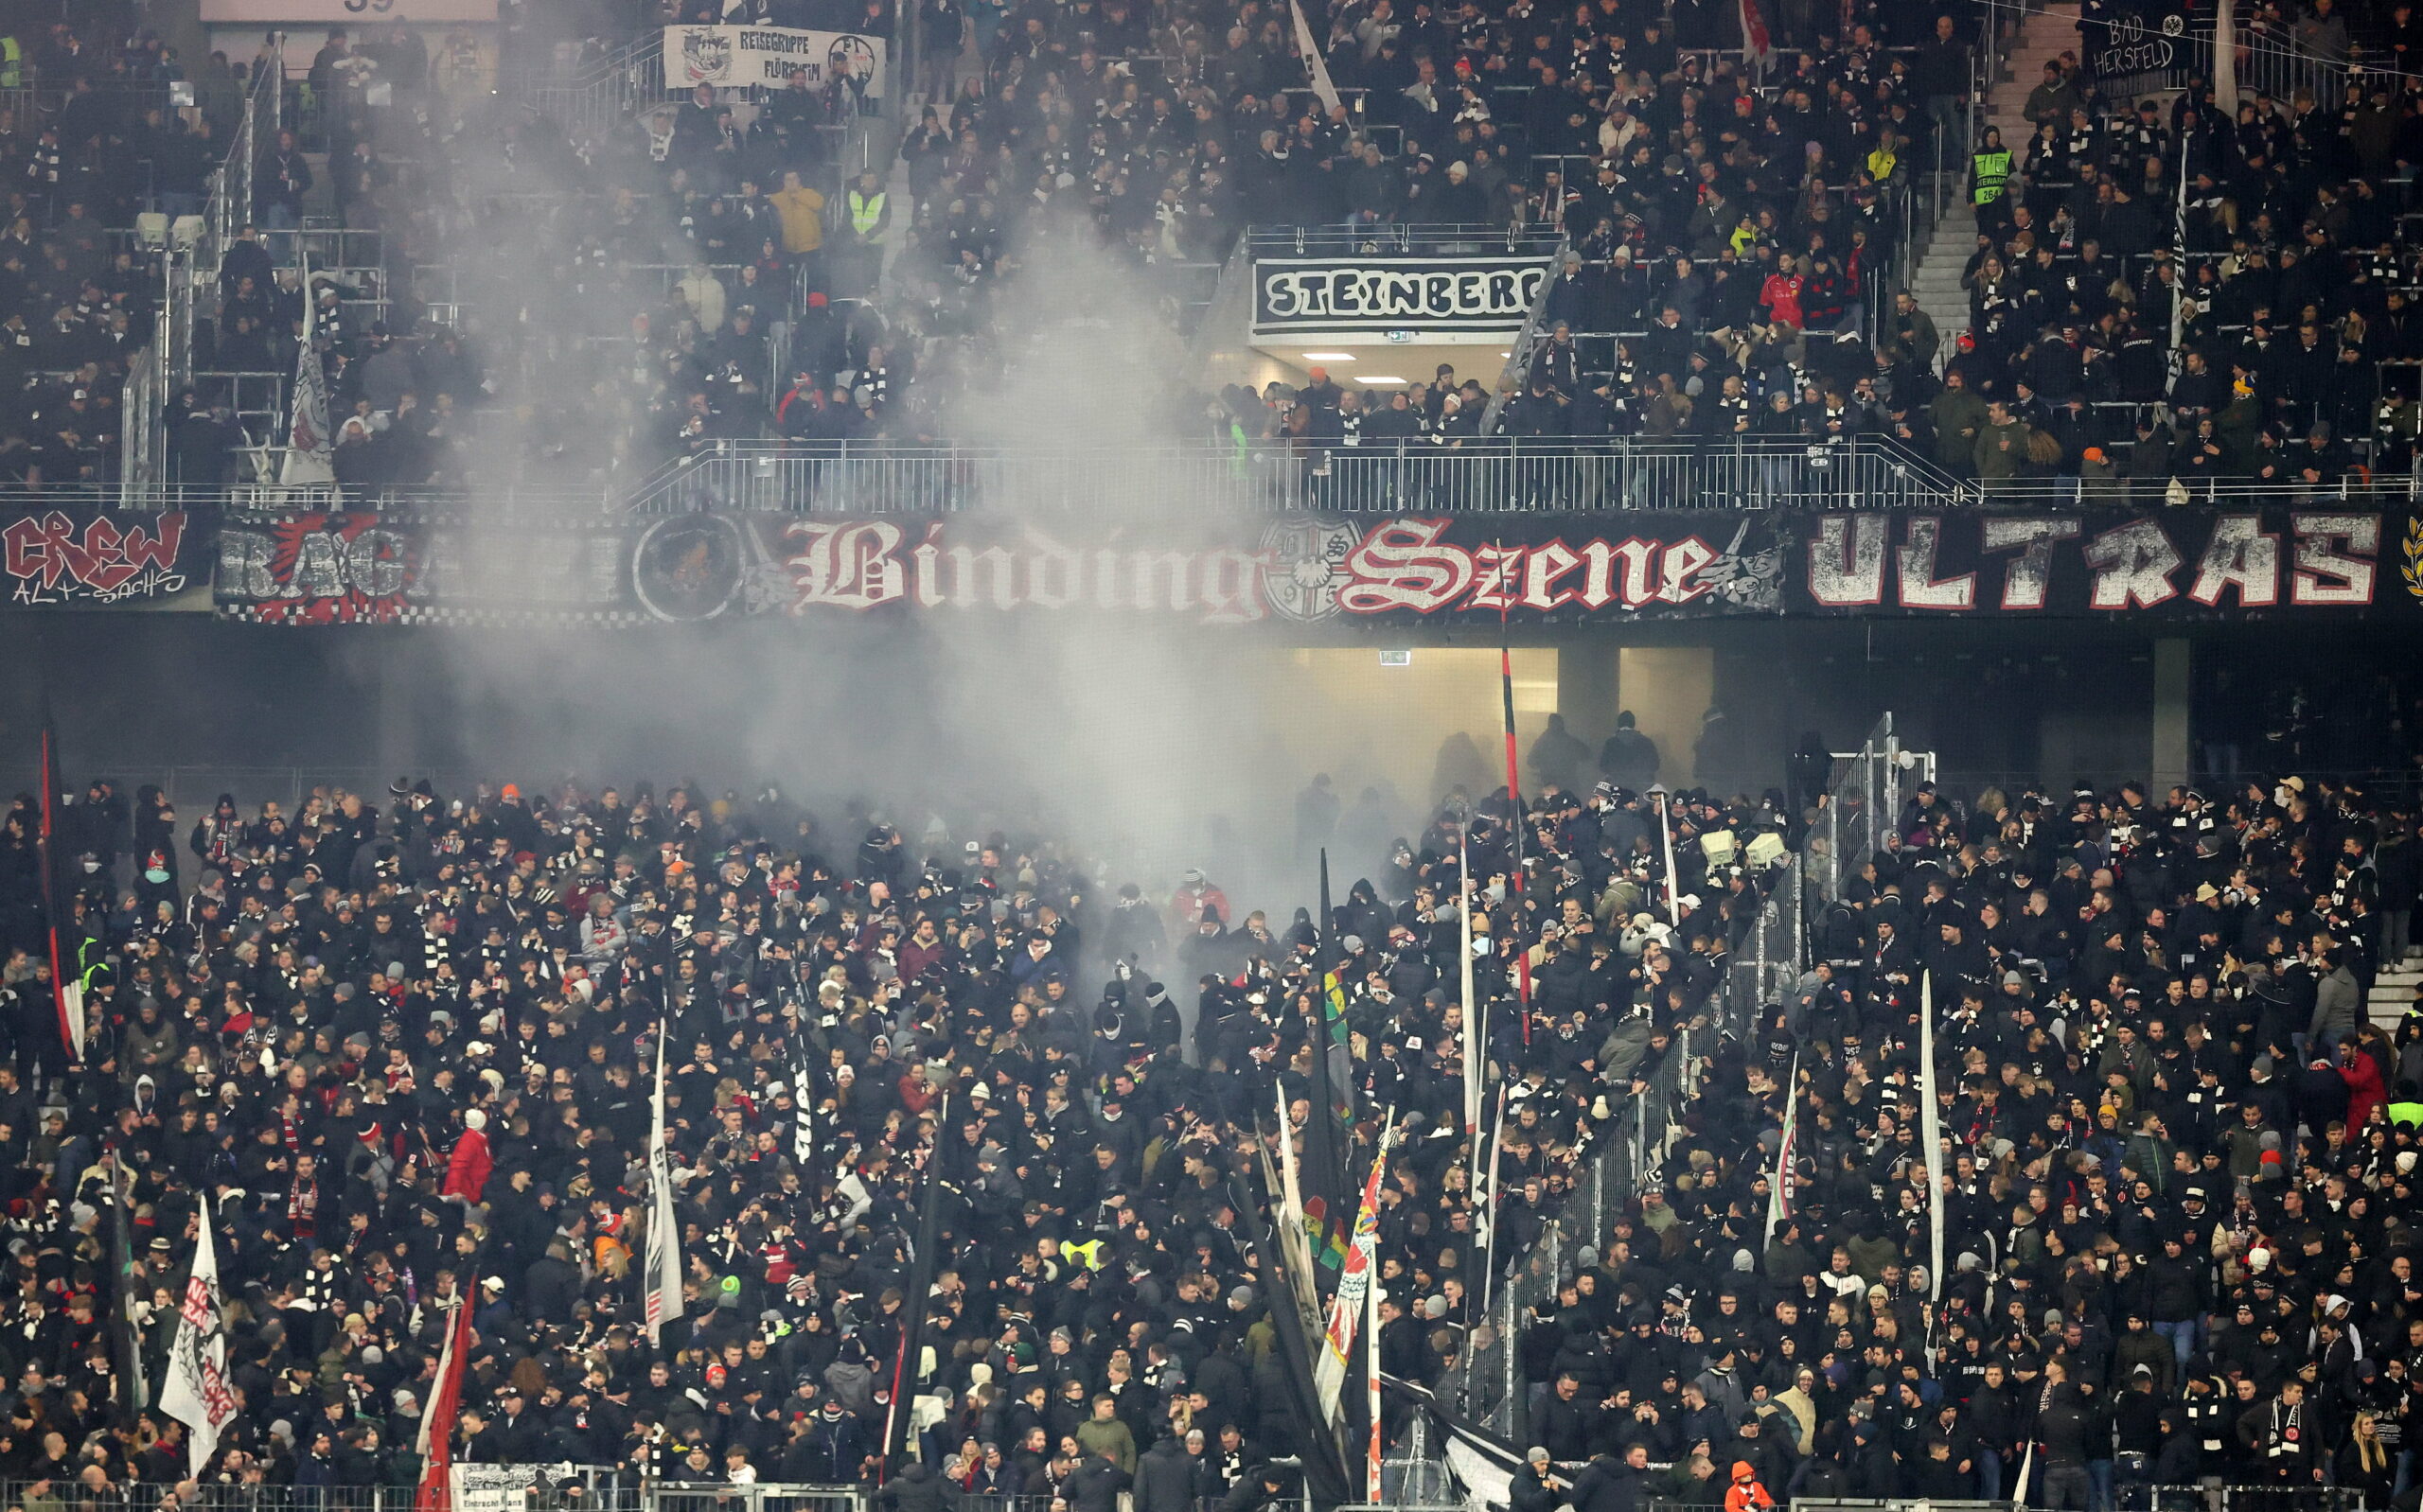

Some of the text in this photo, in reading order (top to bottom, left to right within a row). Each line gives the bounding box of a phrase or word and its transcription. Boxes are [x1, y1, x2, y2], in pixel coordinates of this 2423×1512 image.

[2094, 39, 2173, 77] HERSFELD
[2108, 15, 2144, 45] BAD
[2, 511, 187, 591] CREW
[787, 519, 1273, 624] Binding
[1340, 517, 1724, 614] Szene
[1808, 513, 2381, 610] ULTRAS
